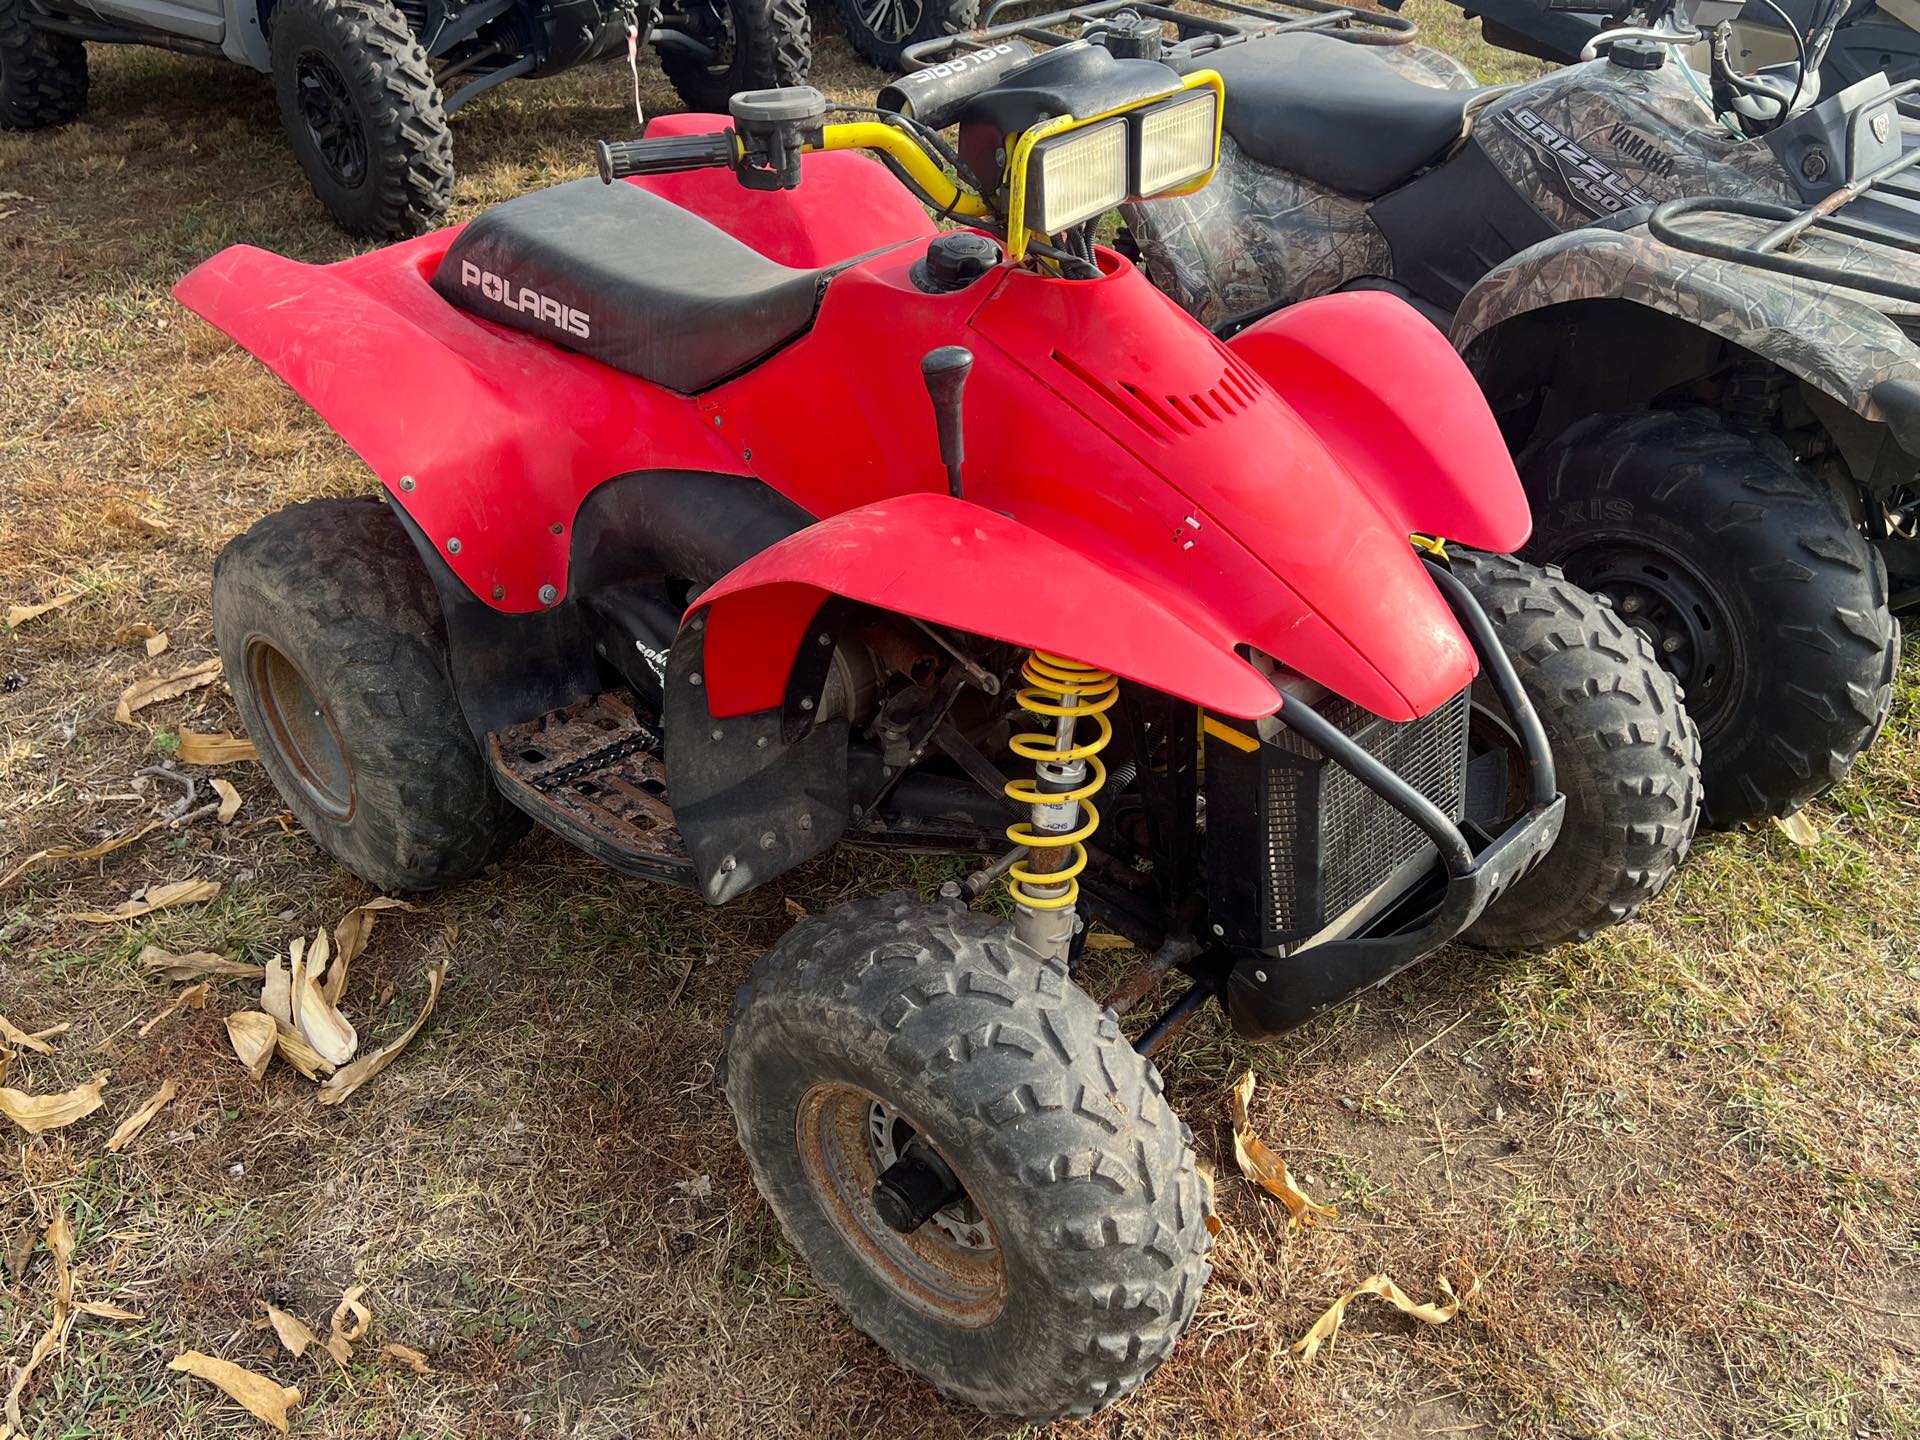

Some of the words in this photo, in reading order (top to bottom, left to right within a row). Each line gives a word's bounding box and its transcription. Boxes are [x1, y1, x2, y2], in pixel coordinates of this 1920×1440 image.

[908, 43, 1014, 84] POLARIS
[1607, 122, 1675, 179] YAMAHA
[1568, 176, 1622, 212] 450
[461, 259, 590, 339] POLARIS
